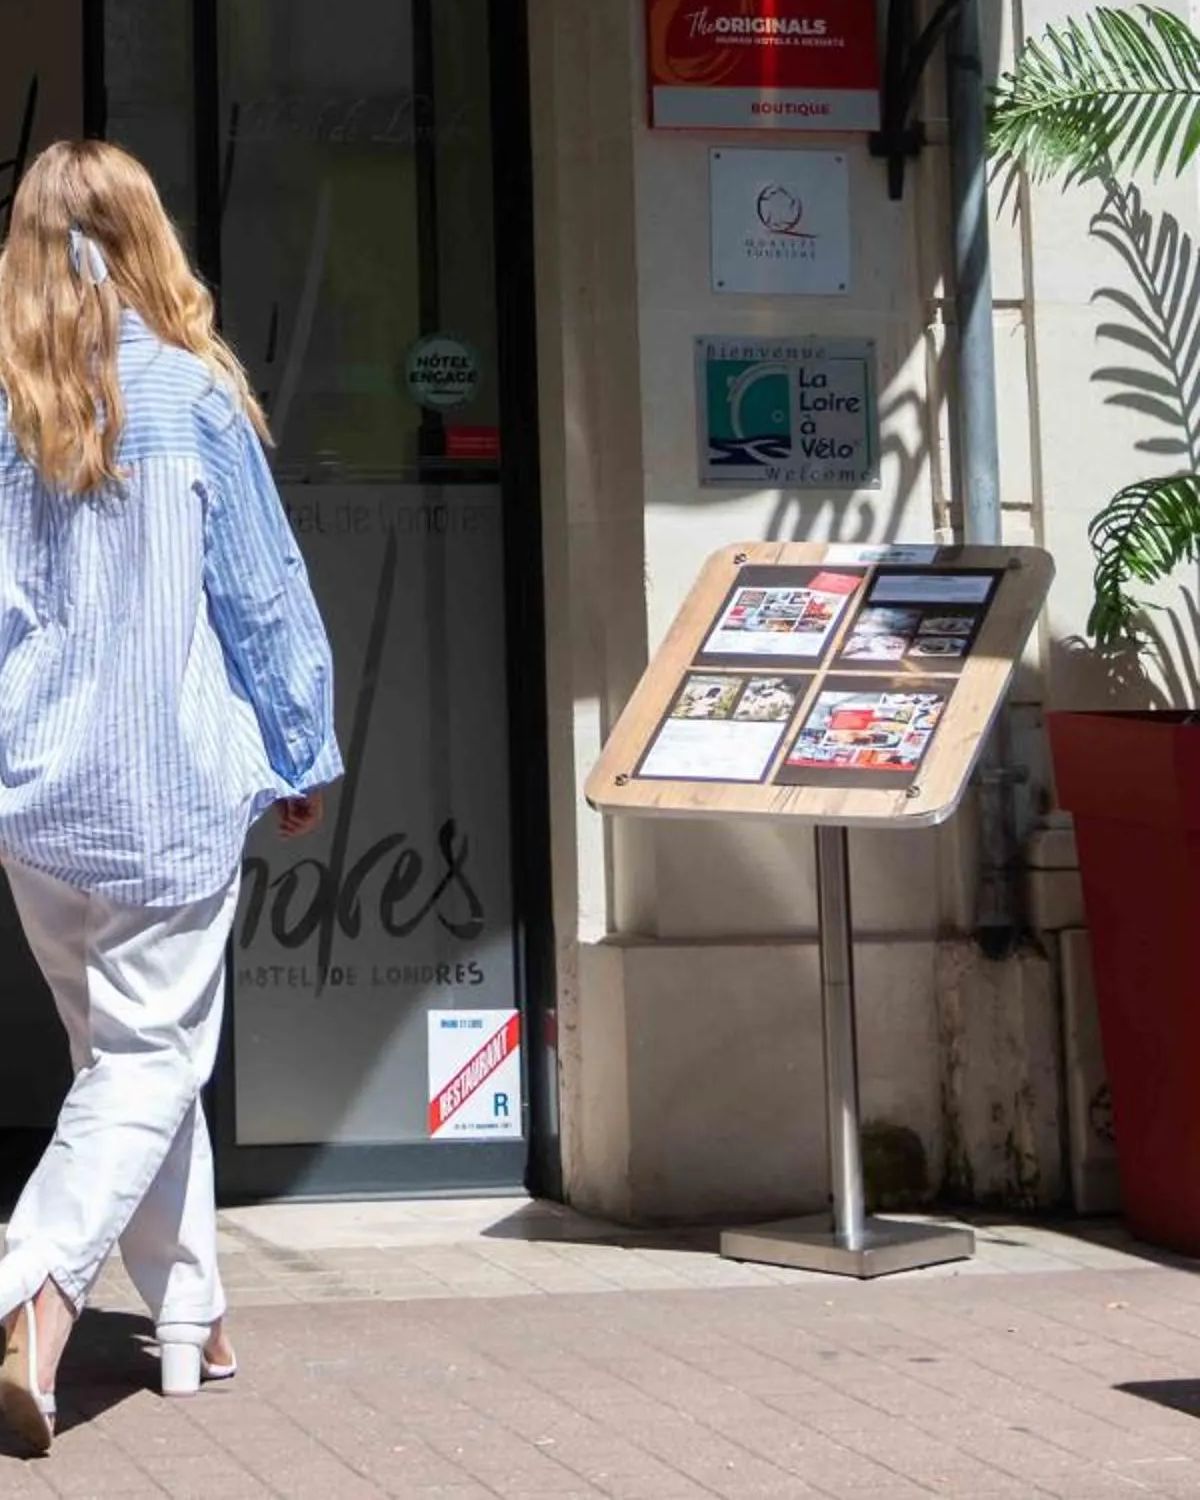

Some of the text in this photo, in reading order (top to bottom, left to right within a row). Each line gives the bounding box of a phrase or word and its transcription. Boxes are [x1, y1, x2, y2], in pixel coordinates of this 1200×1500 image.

[715, 17, 827, 35] ORIGINALS
[751, 103, 830, 117] BOUTIQUE
[799, 368, 828, 388] La
[800, 392, 861, 413] Loire
[800, 414, 817, 435] à
[801, 437, 856, 460] Vélo
[330, 965, 359, 987] DE
[371, 961, 485, 988] LONDRES
[439, 1027, 509, 1122] RESTAURANT
[494, 1092, 509, 1117] R
